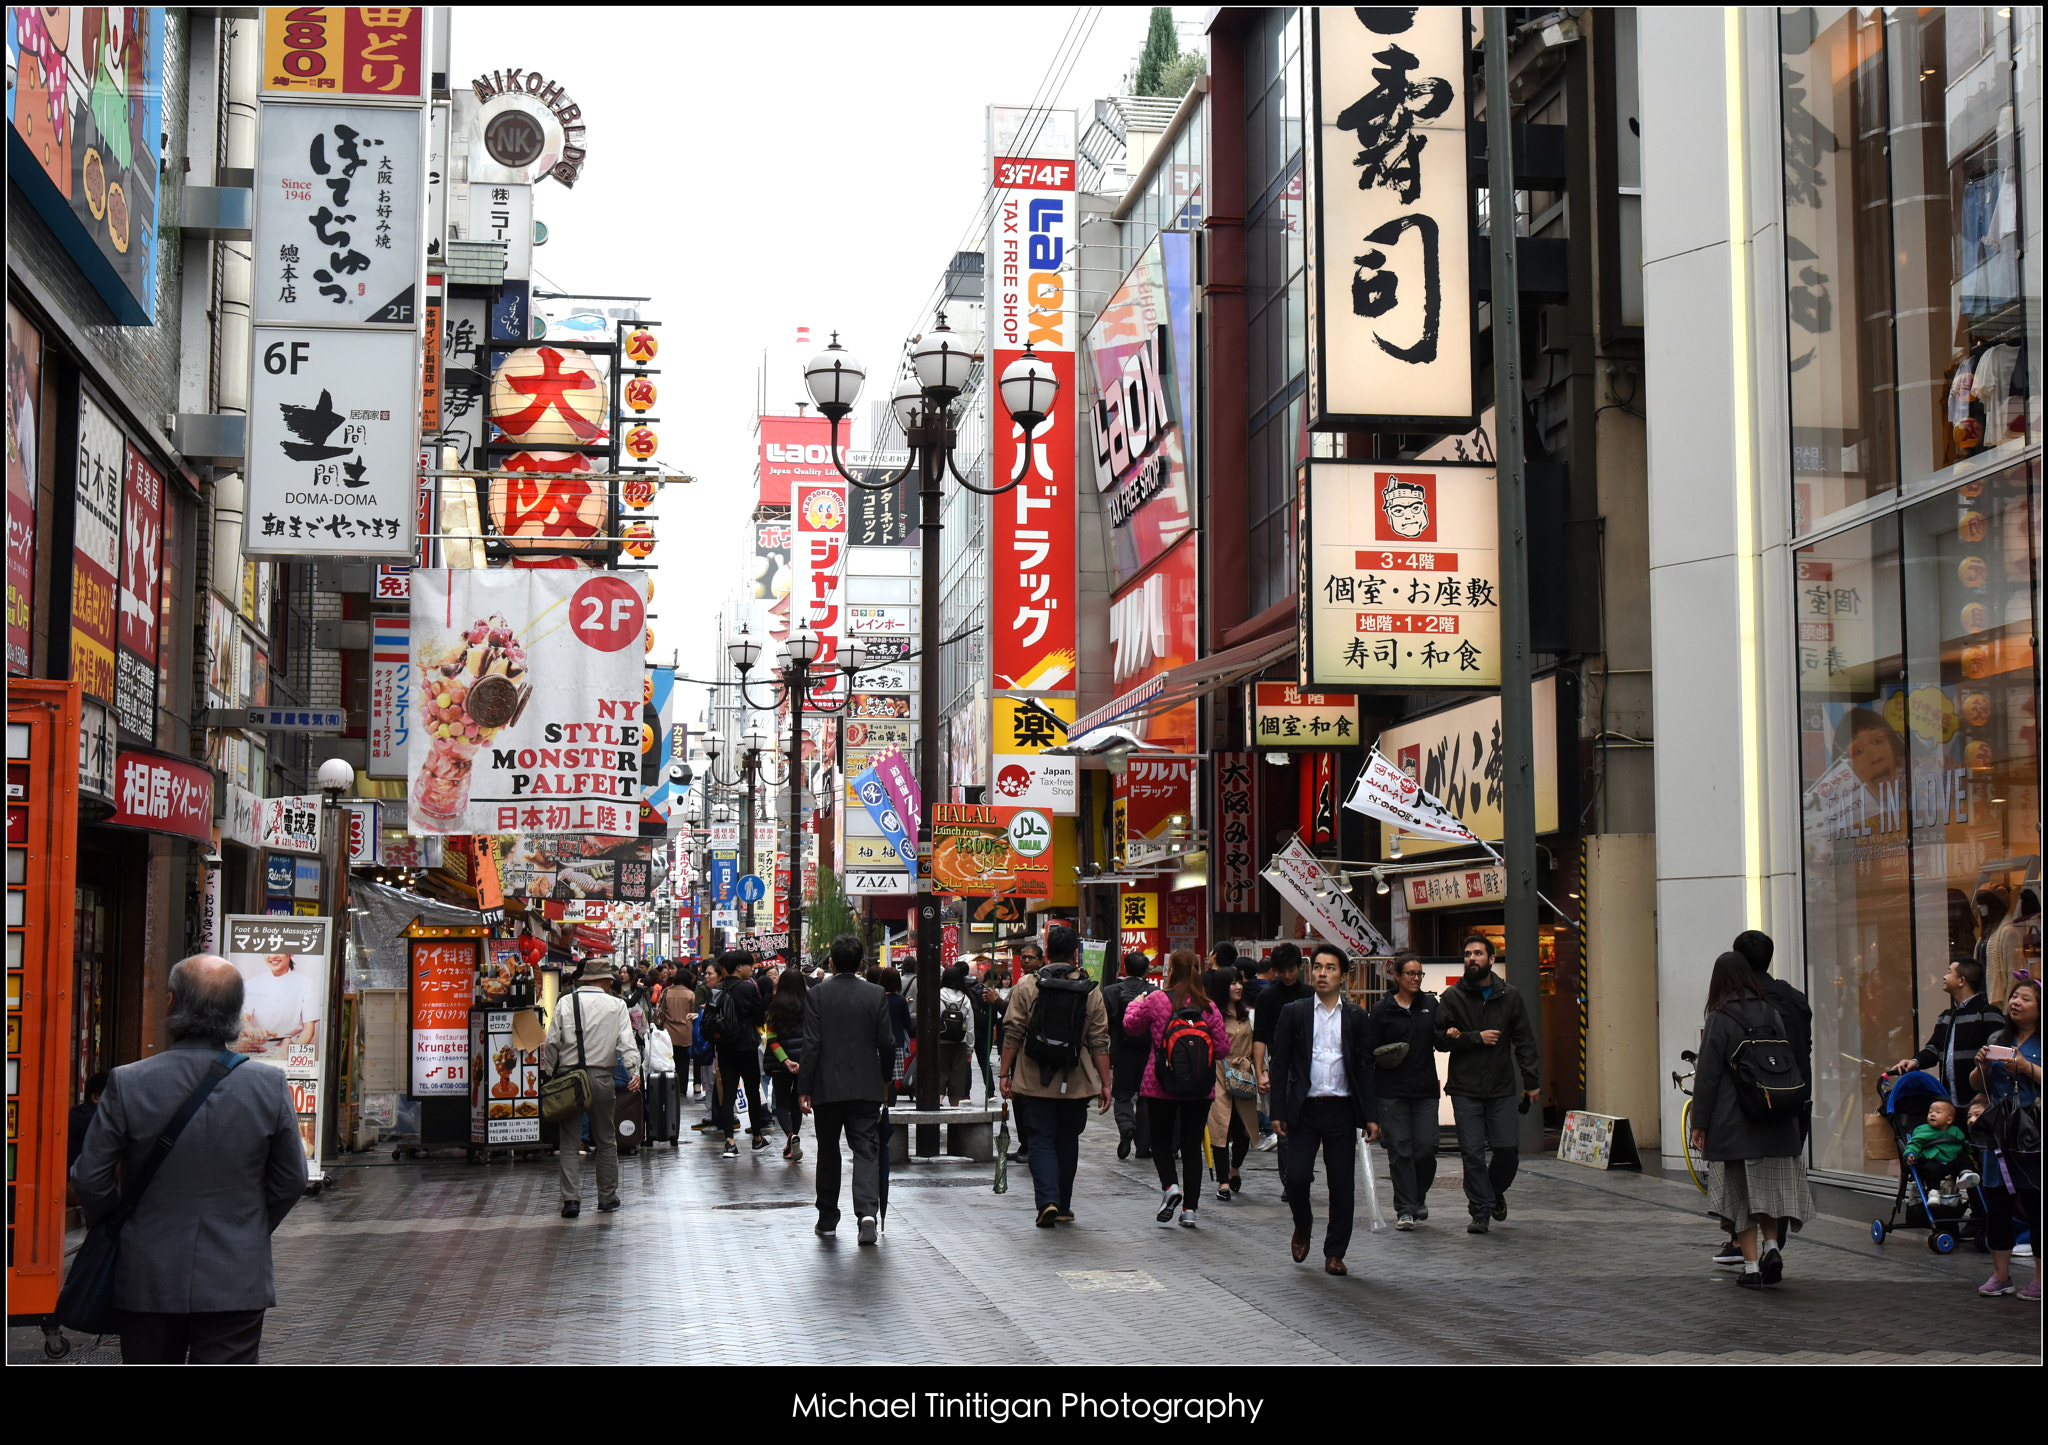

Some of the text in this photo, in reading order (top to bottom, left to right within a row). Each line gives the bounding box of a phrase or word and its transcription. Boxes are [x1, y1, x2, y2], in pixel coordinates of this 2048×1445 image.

[283, 7, 327, 77] 280
[472, 68, 586, 182] NIKOH BLDG
[500, 126, 532, 153] NK
[281, 178, 312, 190] Since
[999, 165, 1069, 186] 3F/4F
[284, 190, 312, 201] 1946
[375, 156, 393, 250] 大阪 お好み焼
[309, 124, 384, 304] ぼてぢゅう
[1003, 200, 1018, 344] TAX FREE SHOP
[387, 306, 411, 320] 2F
[424, 309, 437, 384] 本格インド料理店
[263, 341, 310, 375] 6F
[424, 389, 435, 397] 2F
[485, 347, 598, 536] 大阪
[79, 431, 117, 519] 白木屋
[769, 467, 791, 475] Japan
[794, 468, 823, 476] Quality
[285, 493, 377, 506] DOMA-DOMA
[1108, 456, 1160, 528] TAX FREE SHOP
[261, 512, 400, 539] 朝までやってます
[1323, 574, 1497, 607] 個室・お座敷
[580, 597, 634, 631] 2F
[851, 609, 884, 617] カラオケ
[856, 619, 905, 631] レインボー
[1343, 638, 1481, 671] 寿司・和食
[598, 699, 640, 721] NY
[545, 723, 639, 746] STYLE
[1014, 706, 1055, 747] 薬
[1260, 715, 1353, 737] 個室・和食
[673, 725, 684, 760] カラオ
[492, 749, 637, 771] MONSTER
[1040, 777, 1073, 787] Tax-free
[1043, 767, 1073, 777] Japan.
[1130, 762, 1188, 781] ツルハ
[123, 761, 210, 824] 相席ダイニング
[512, 775, 636, 796] PALFEIT
[1052, 787, 1073, 797] Shop
[1130, 785, 1178, 798] ドラッグ
[936, 805, 996, 824] HALAL
[1827, 768, 1968, 841] FALL IN LOVE
[284, 808, 316, 835] 電球屋
[497, 806, 631, 831] 日本初上陸！
[1014, 817, 1047, 838] حلال
[935, 825, 980, 836] Lunch from
[1222, 761, 1254, 904] 大阪みやげ
[1018, 840, 1042, 850] HALAL
[975, 856, 1049, 876] مطعم حلال
[856, 876, 898, 887] ZAZA
[1021, 880, 1046, 888] Indian
[587, 906, 604, 916] 2F
[1124, 897, 1147, 924] 薬
[234, 935, 317, 952] マッサージ
[416, 947, 473, 966] タイ料理
[299, 1045, 314, 1053] 15分
[290, 1056, 314, 1066] 990円
[448, 1066, 464, 1079] B1
